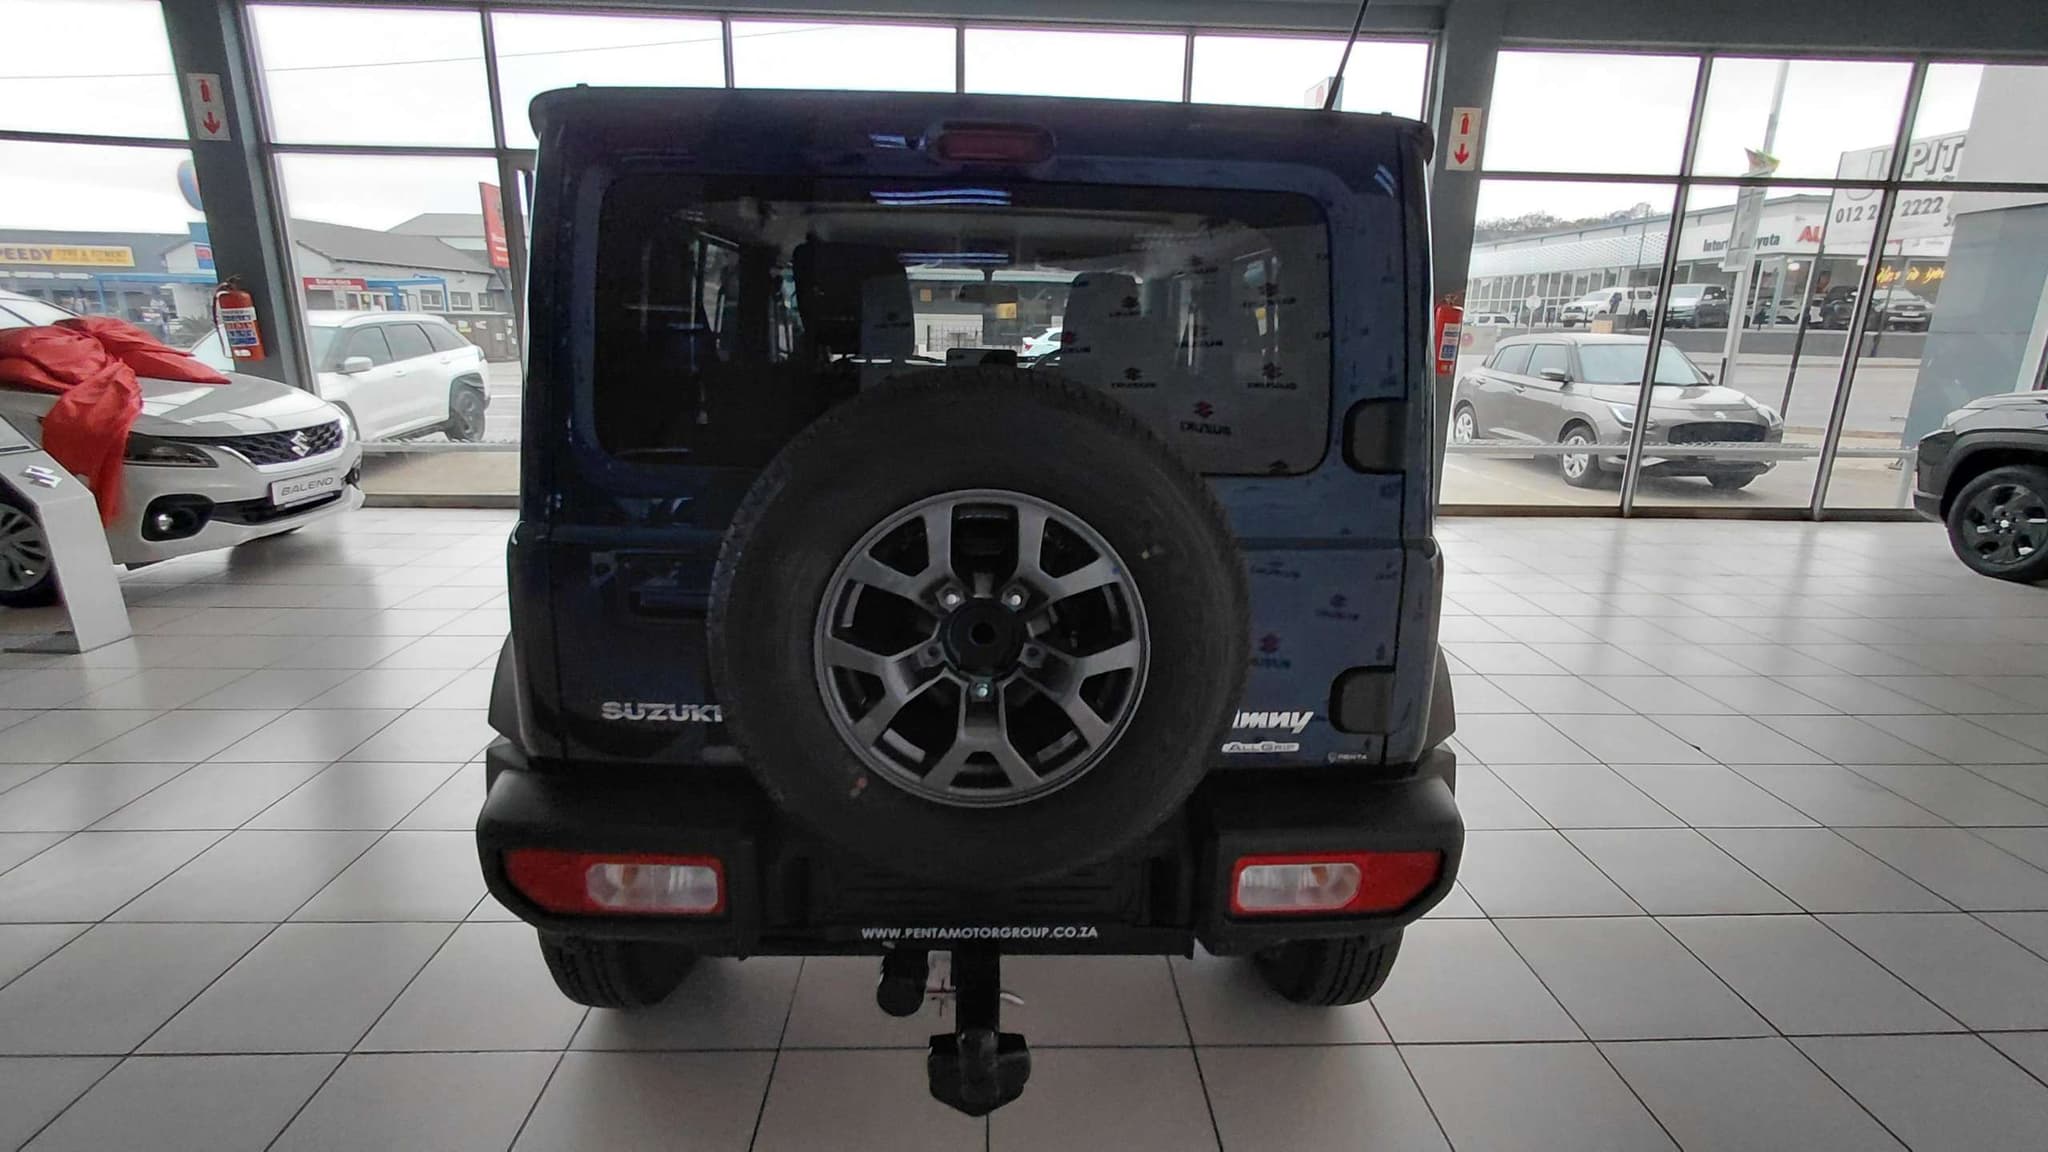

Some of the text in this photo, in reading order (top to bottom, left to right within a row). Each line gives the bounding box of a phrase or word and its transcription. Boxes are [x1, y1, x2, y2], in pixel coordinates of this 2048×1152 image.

[1835, 205, 1864, 223] 012
[1901, 196, 1945, 218] 2222
[281, 477, 334, 496] BALENO
[601, 701, 723, 722] SUZUKI
[861, 926, 1098, 940] WWW.PENTAMOTORGROUP.CO.ZA
